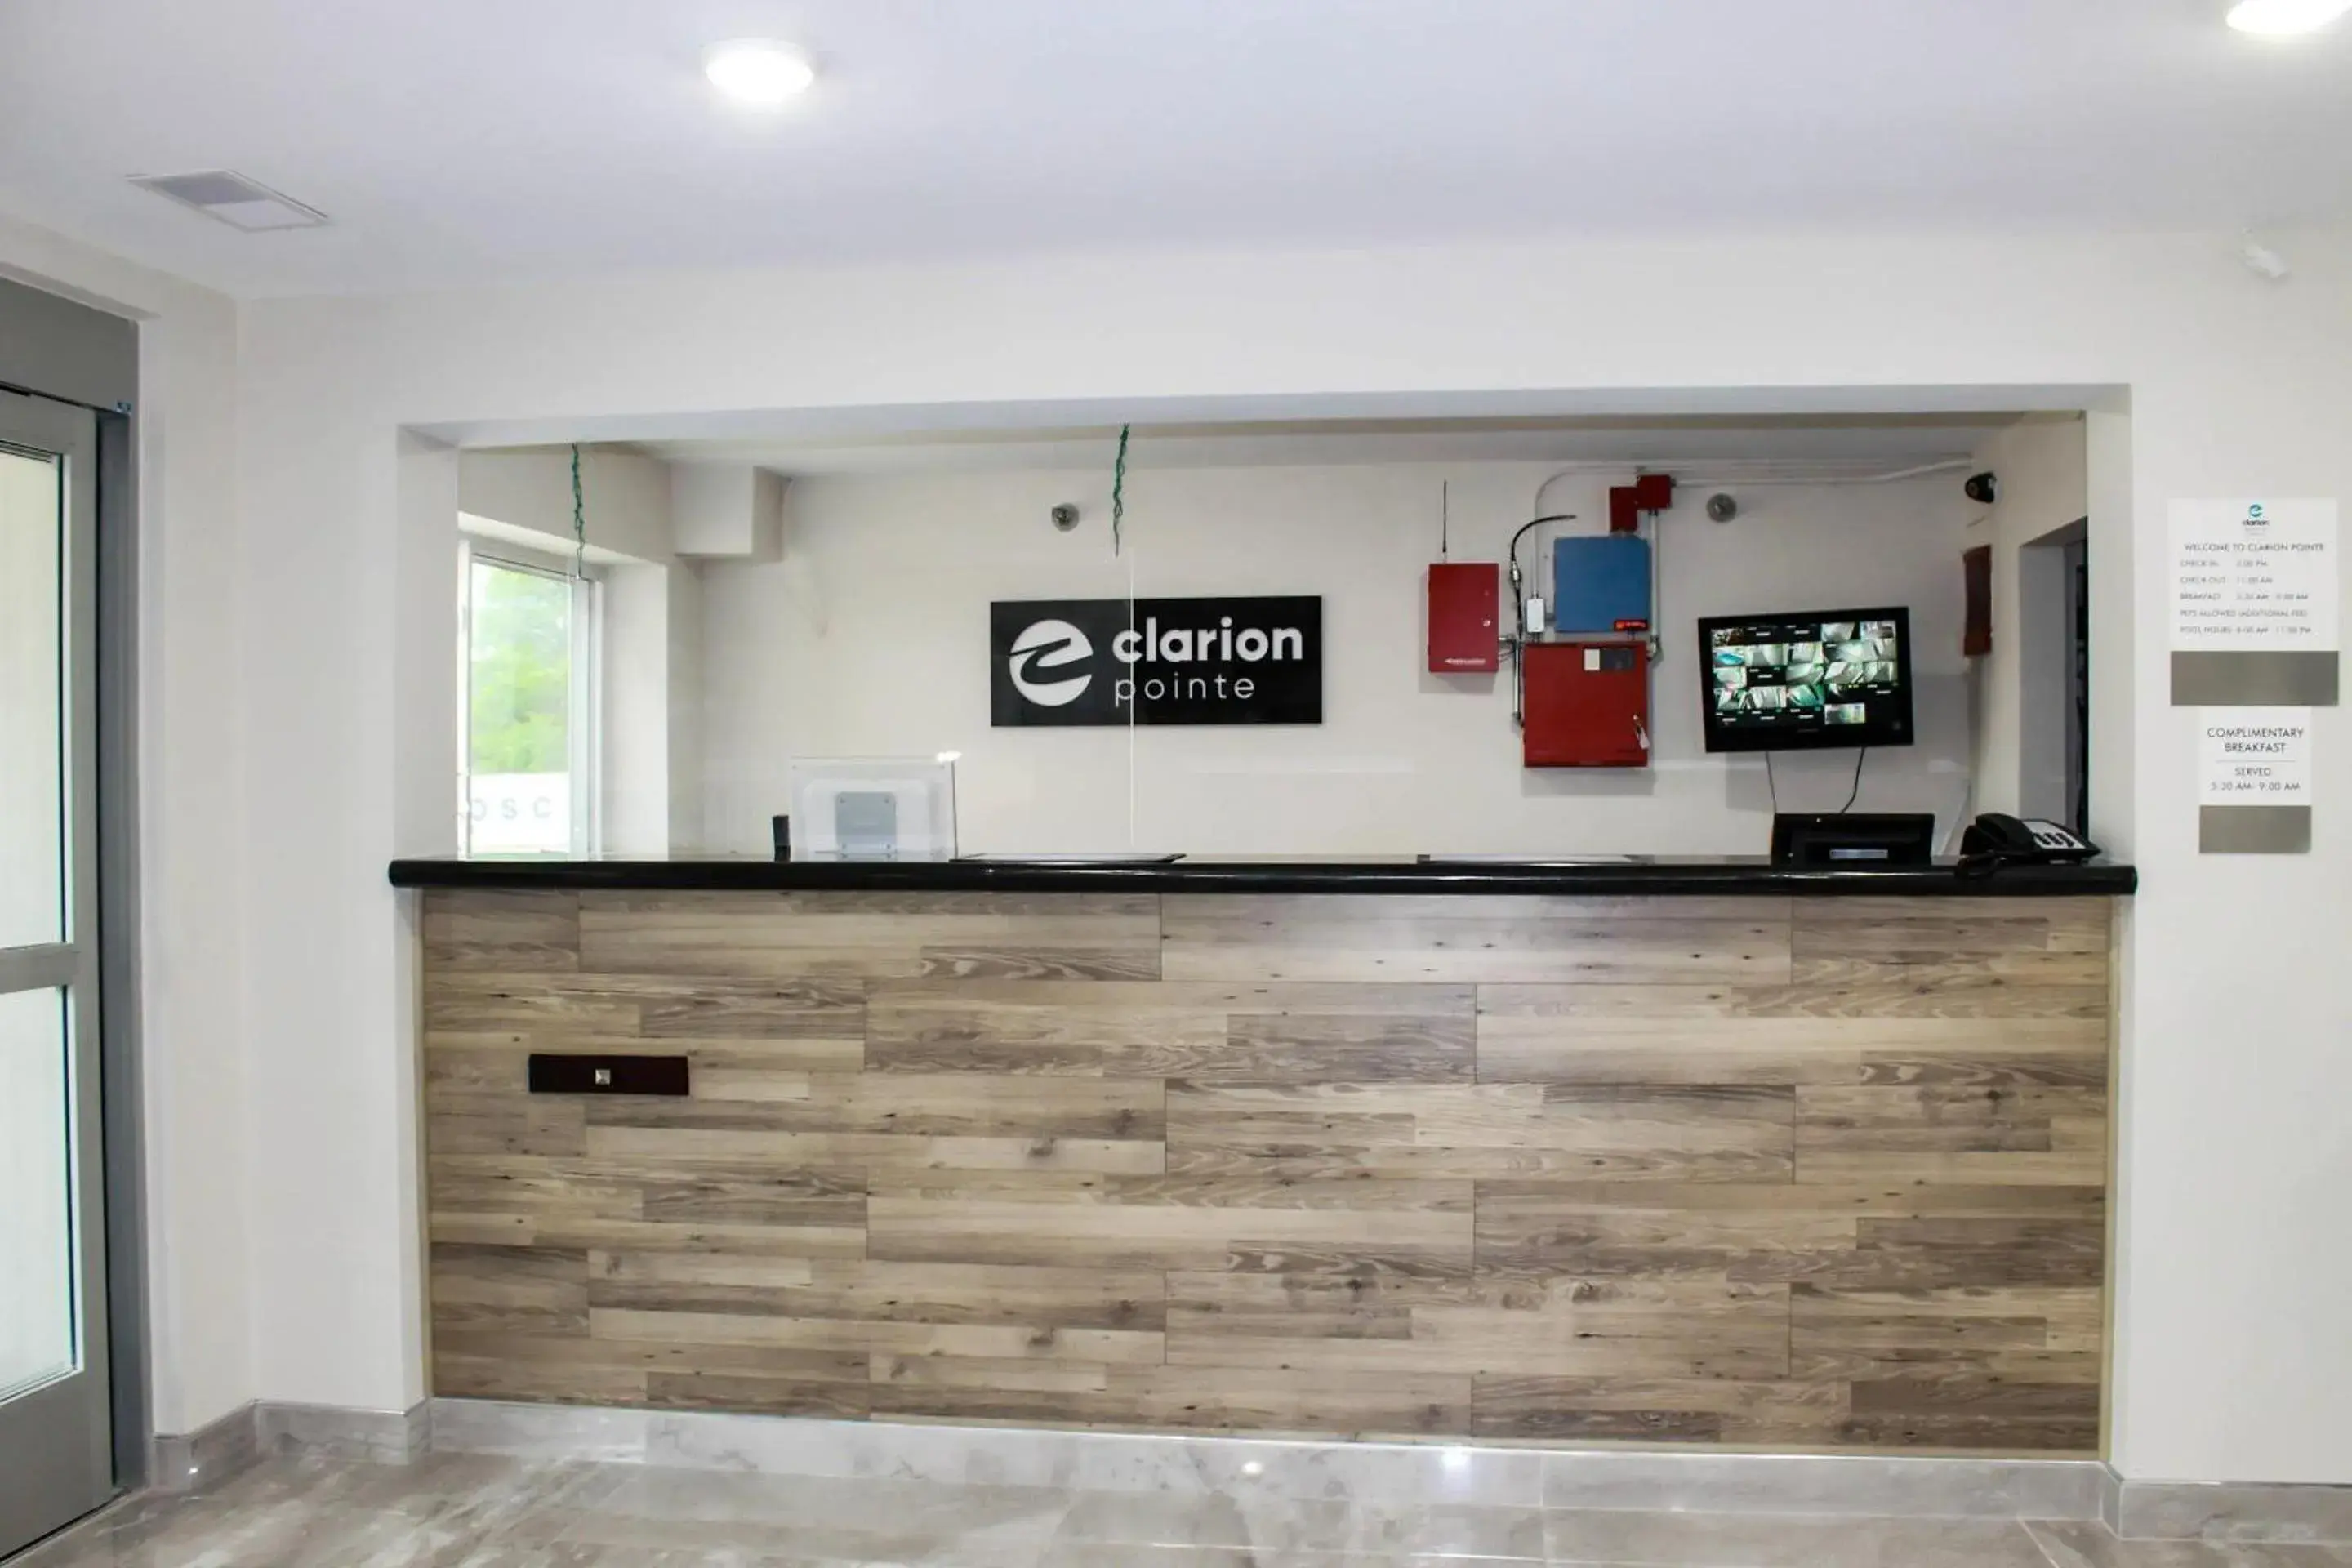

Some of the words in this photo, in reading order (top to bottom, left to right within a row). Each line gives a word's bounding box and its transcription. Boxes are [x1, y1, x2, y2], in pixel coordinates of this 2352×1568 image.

[2184, 543, 2230, 552] WELCOME
[2232, 543, 2245, 552] TO
[2247, 543, 2287, 552] CLARION
[2290, 543, 2324, 552] POINTE
[2199, 609, 2236, 617] ALLOWED
[1111, 616, 1303, 663] clarion
[1115, 671, 1256, 708] pointe
[2207, 727, 2304, 738] COMPLIMENTARY
[2224, 742, 2286, 753] BREAKFAST
[2234, 767, 2271, 777] SERVED
[2283, 782, 2301, 791] AM
